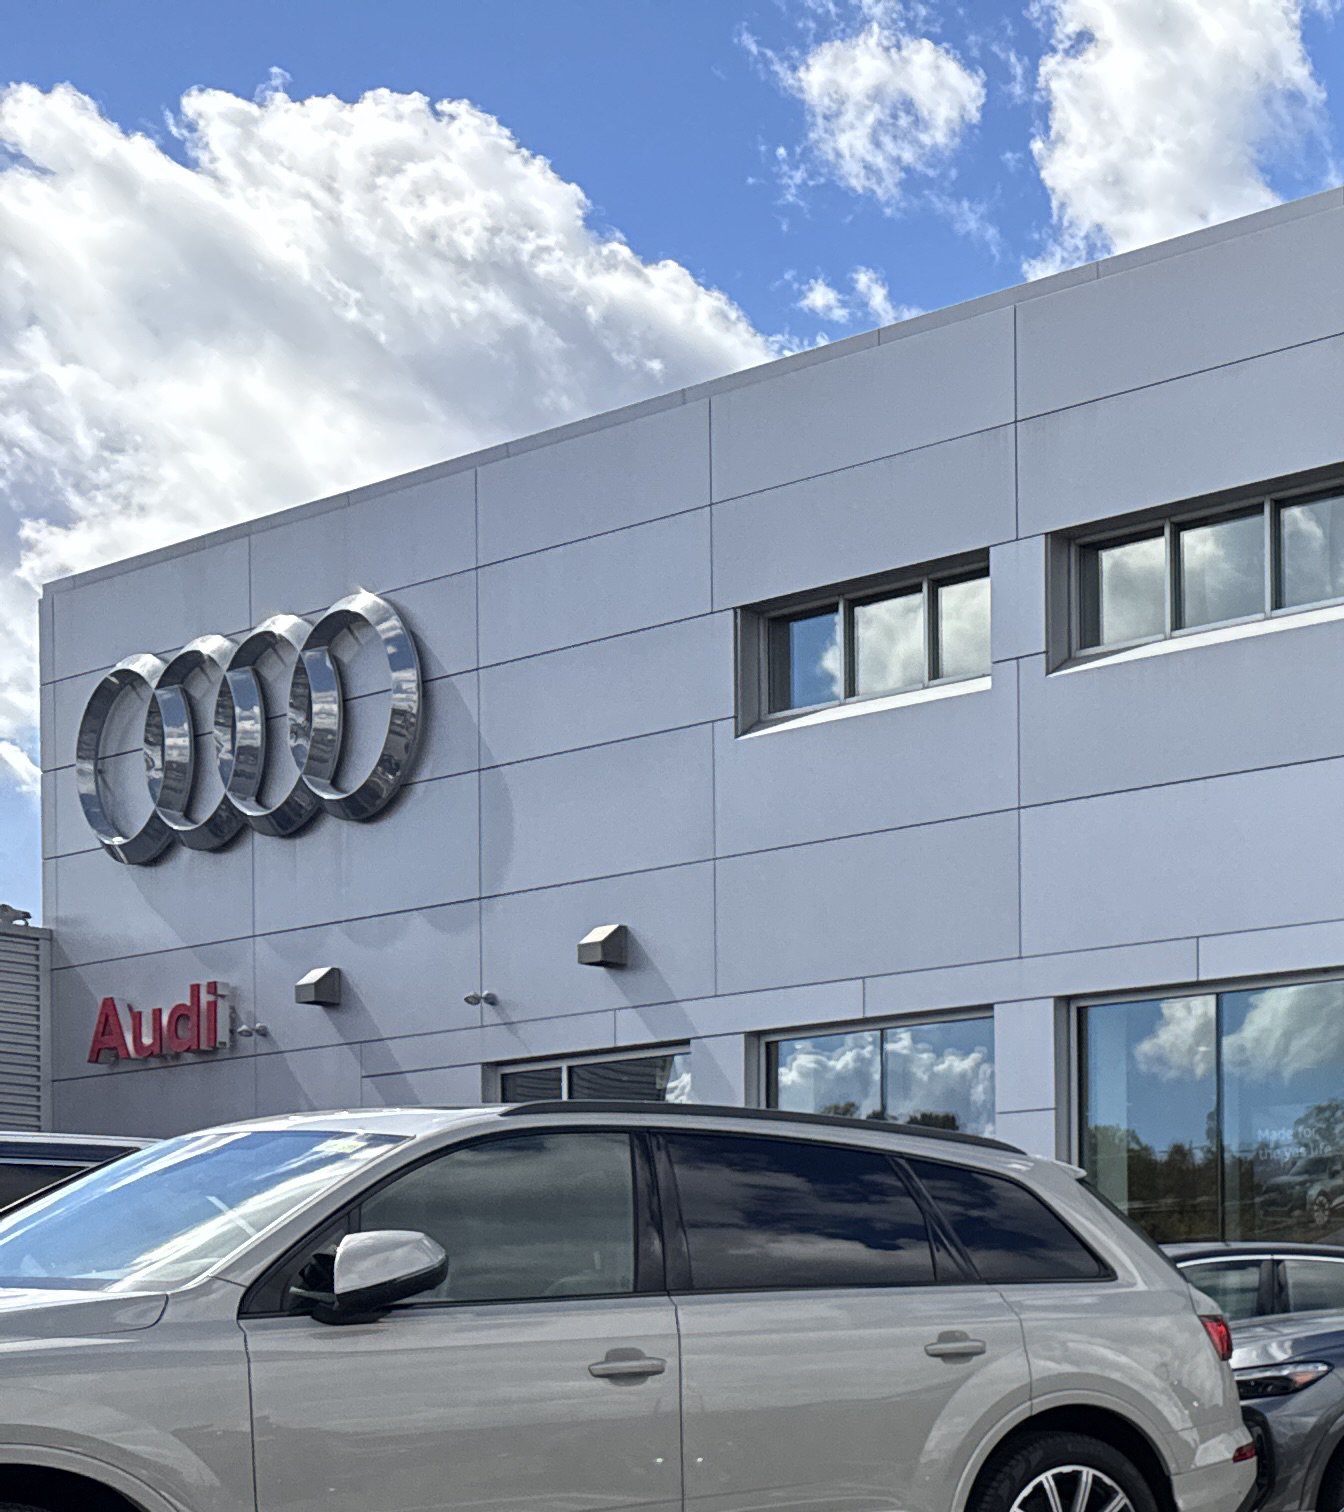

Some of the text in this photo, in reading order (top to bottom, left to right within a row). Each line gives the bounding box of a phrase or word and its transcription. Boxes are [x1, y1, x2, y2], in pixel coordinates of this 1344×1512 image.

[87, 981, 224, 1063] Audi
[1257, 1124, 1317, 1141] Made for
